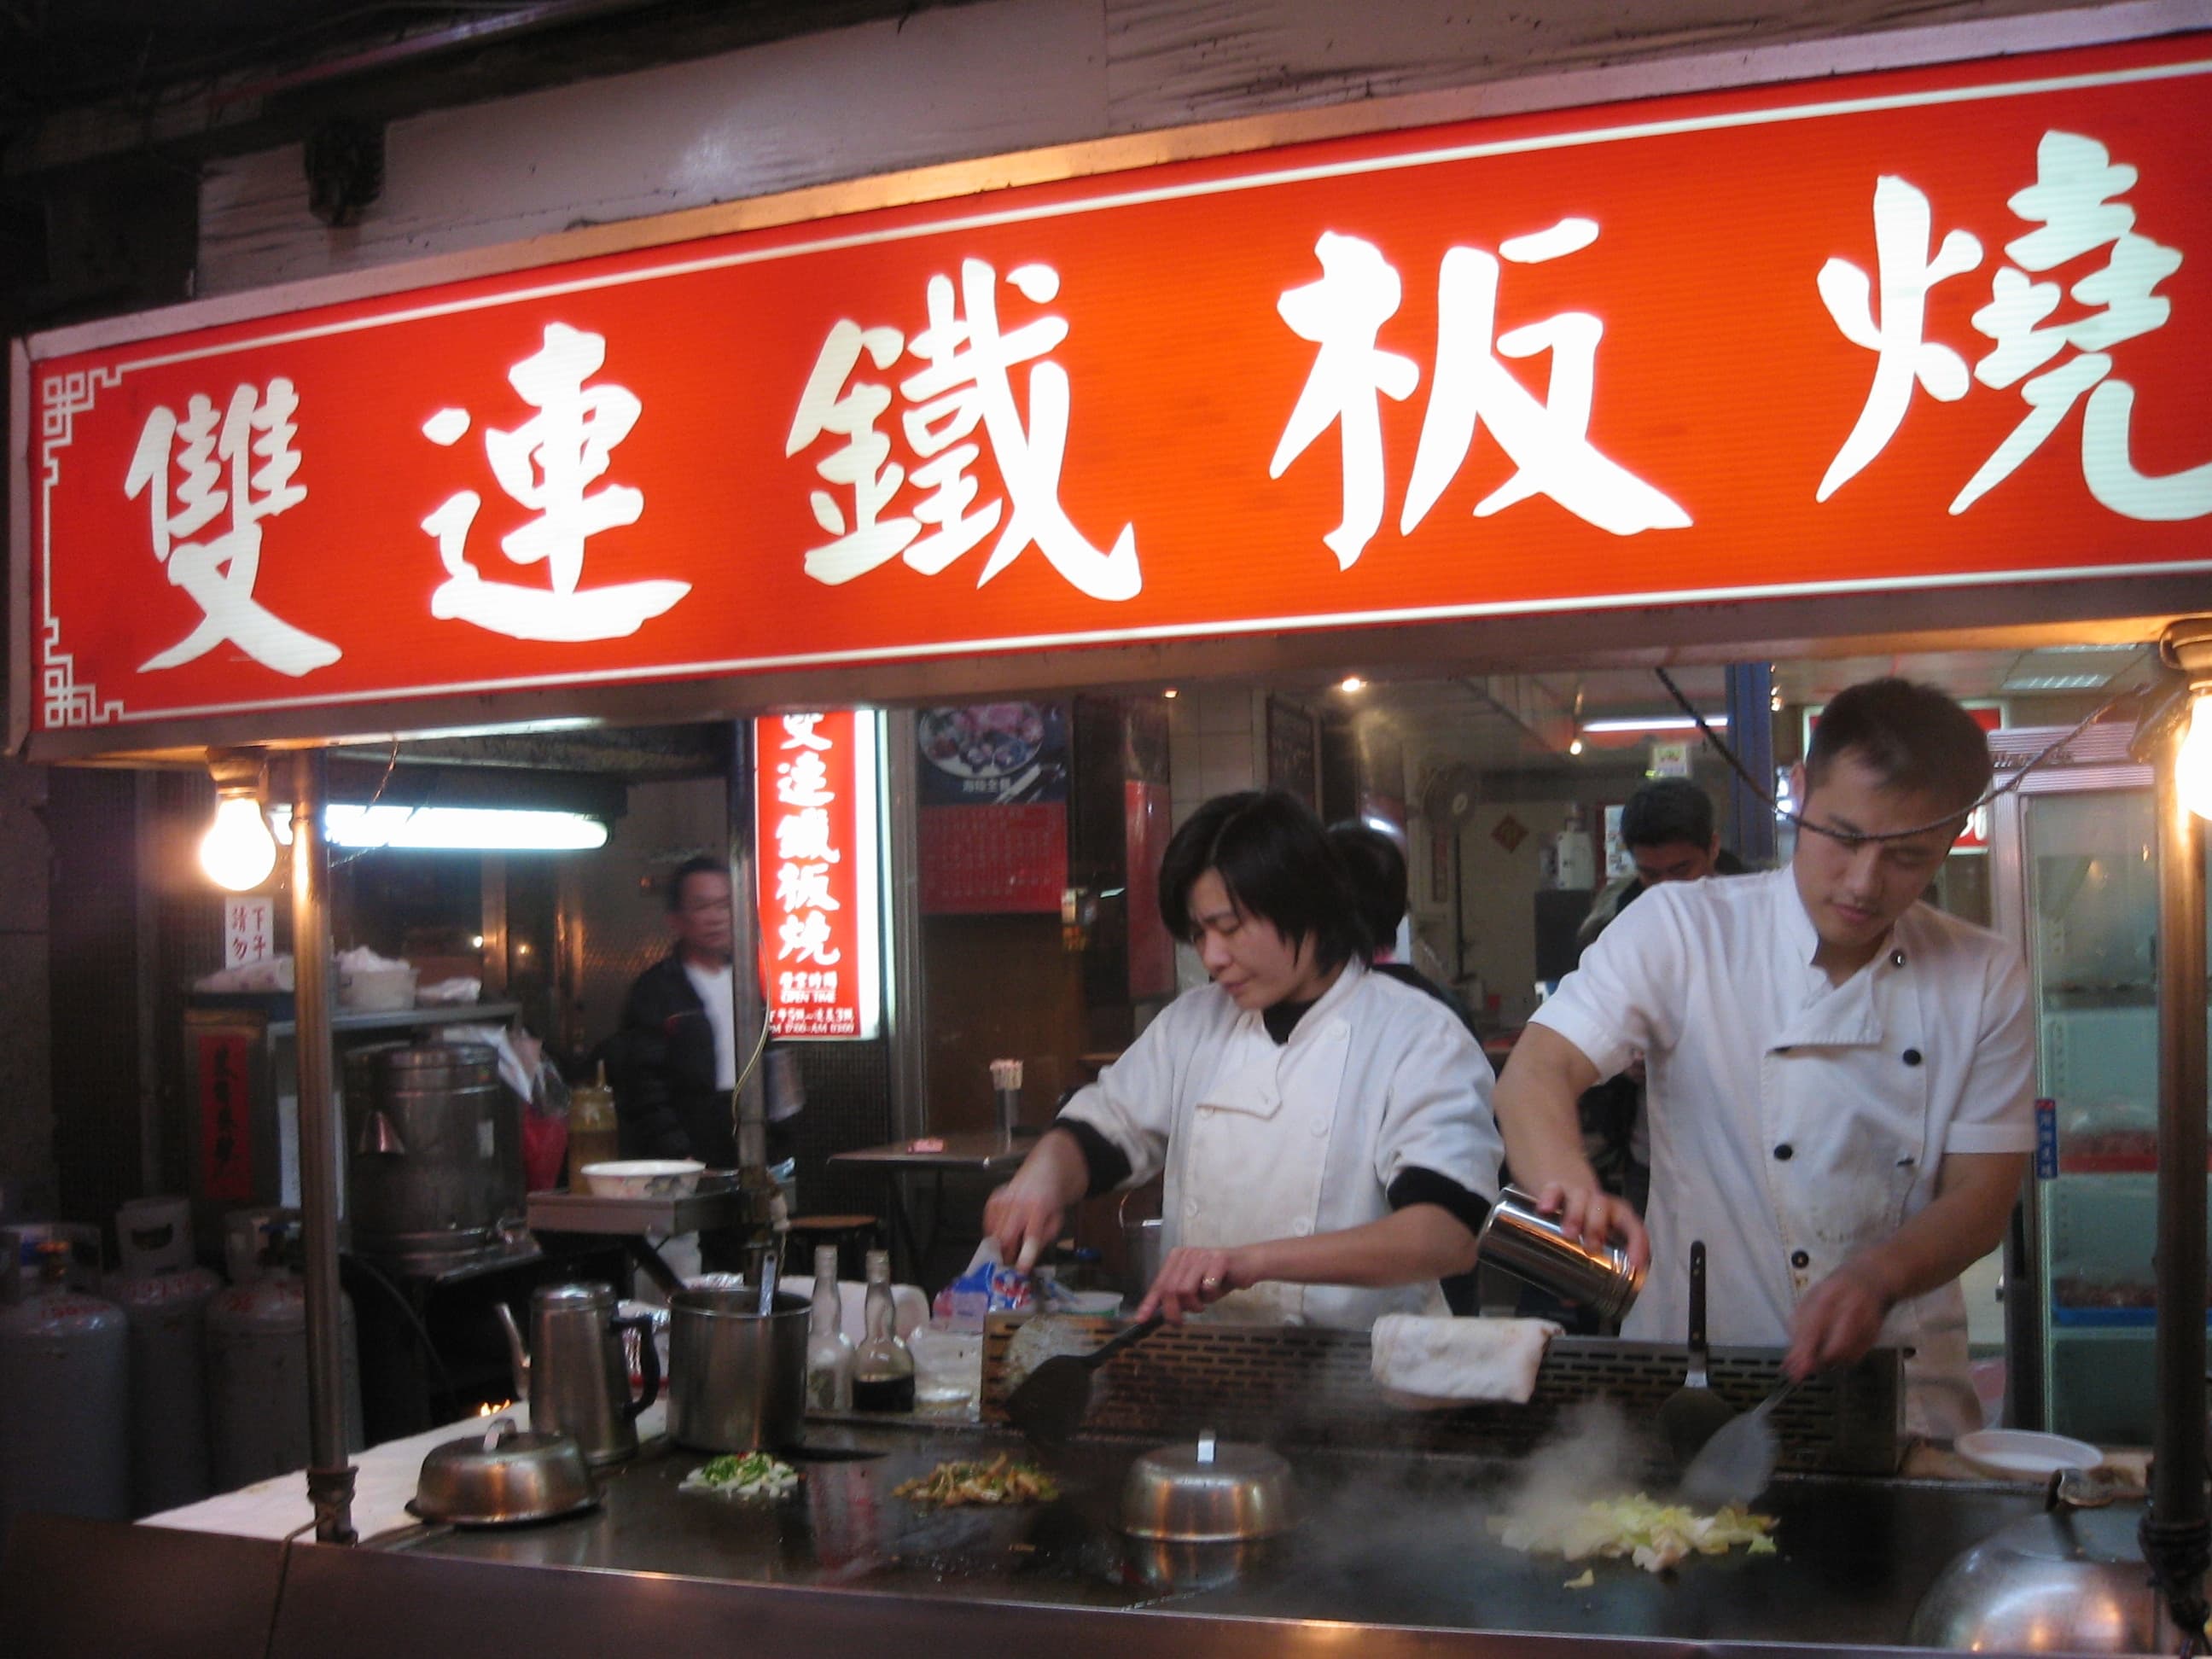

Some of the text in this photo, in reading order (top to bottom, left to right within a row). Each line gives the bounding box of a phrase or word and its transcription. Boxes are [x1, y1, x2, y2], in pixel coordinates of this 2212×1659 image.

[124, 131, 2212, 677] 雙連鐵板燒
